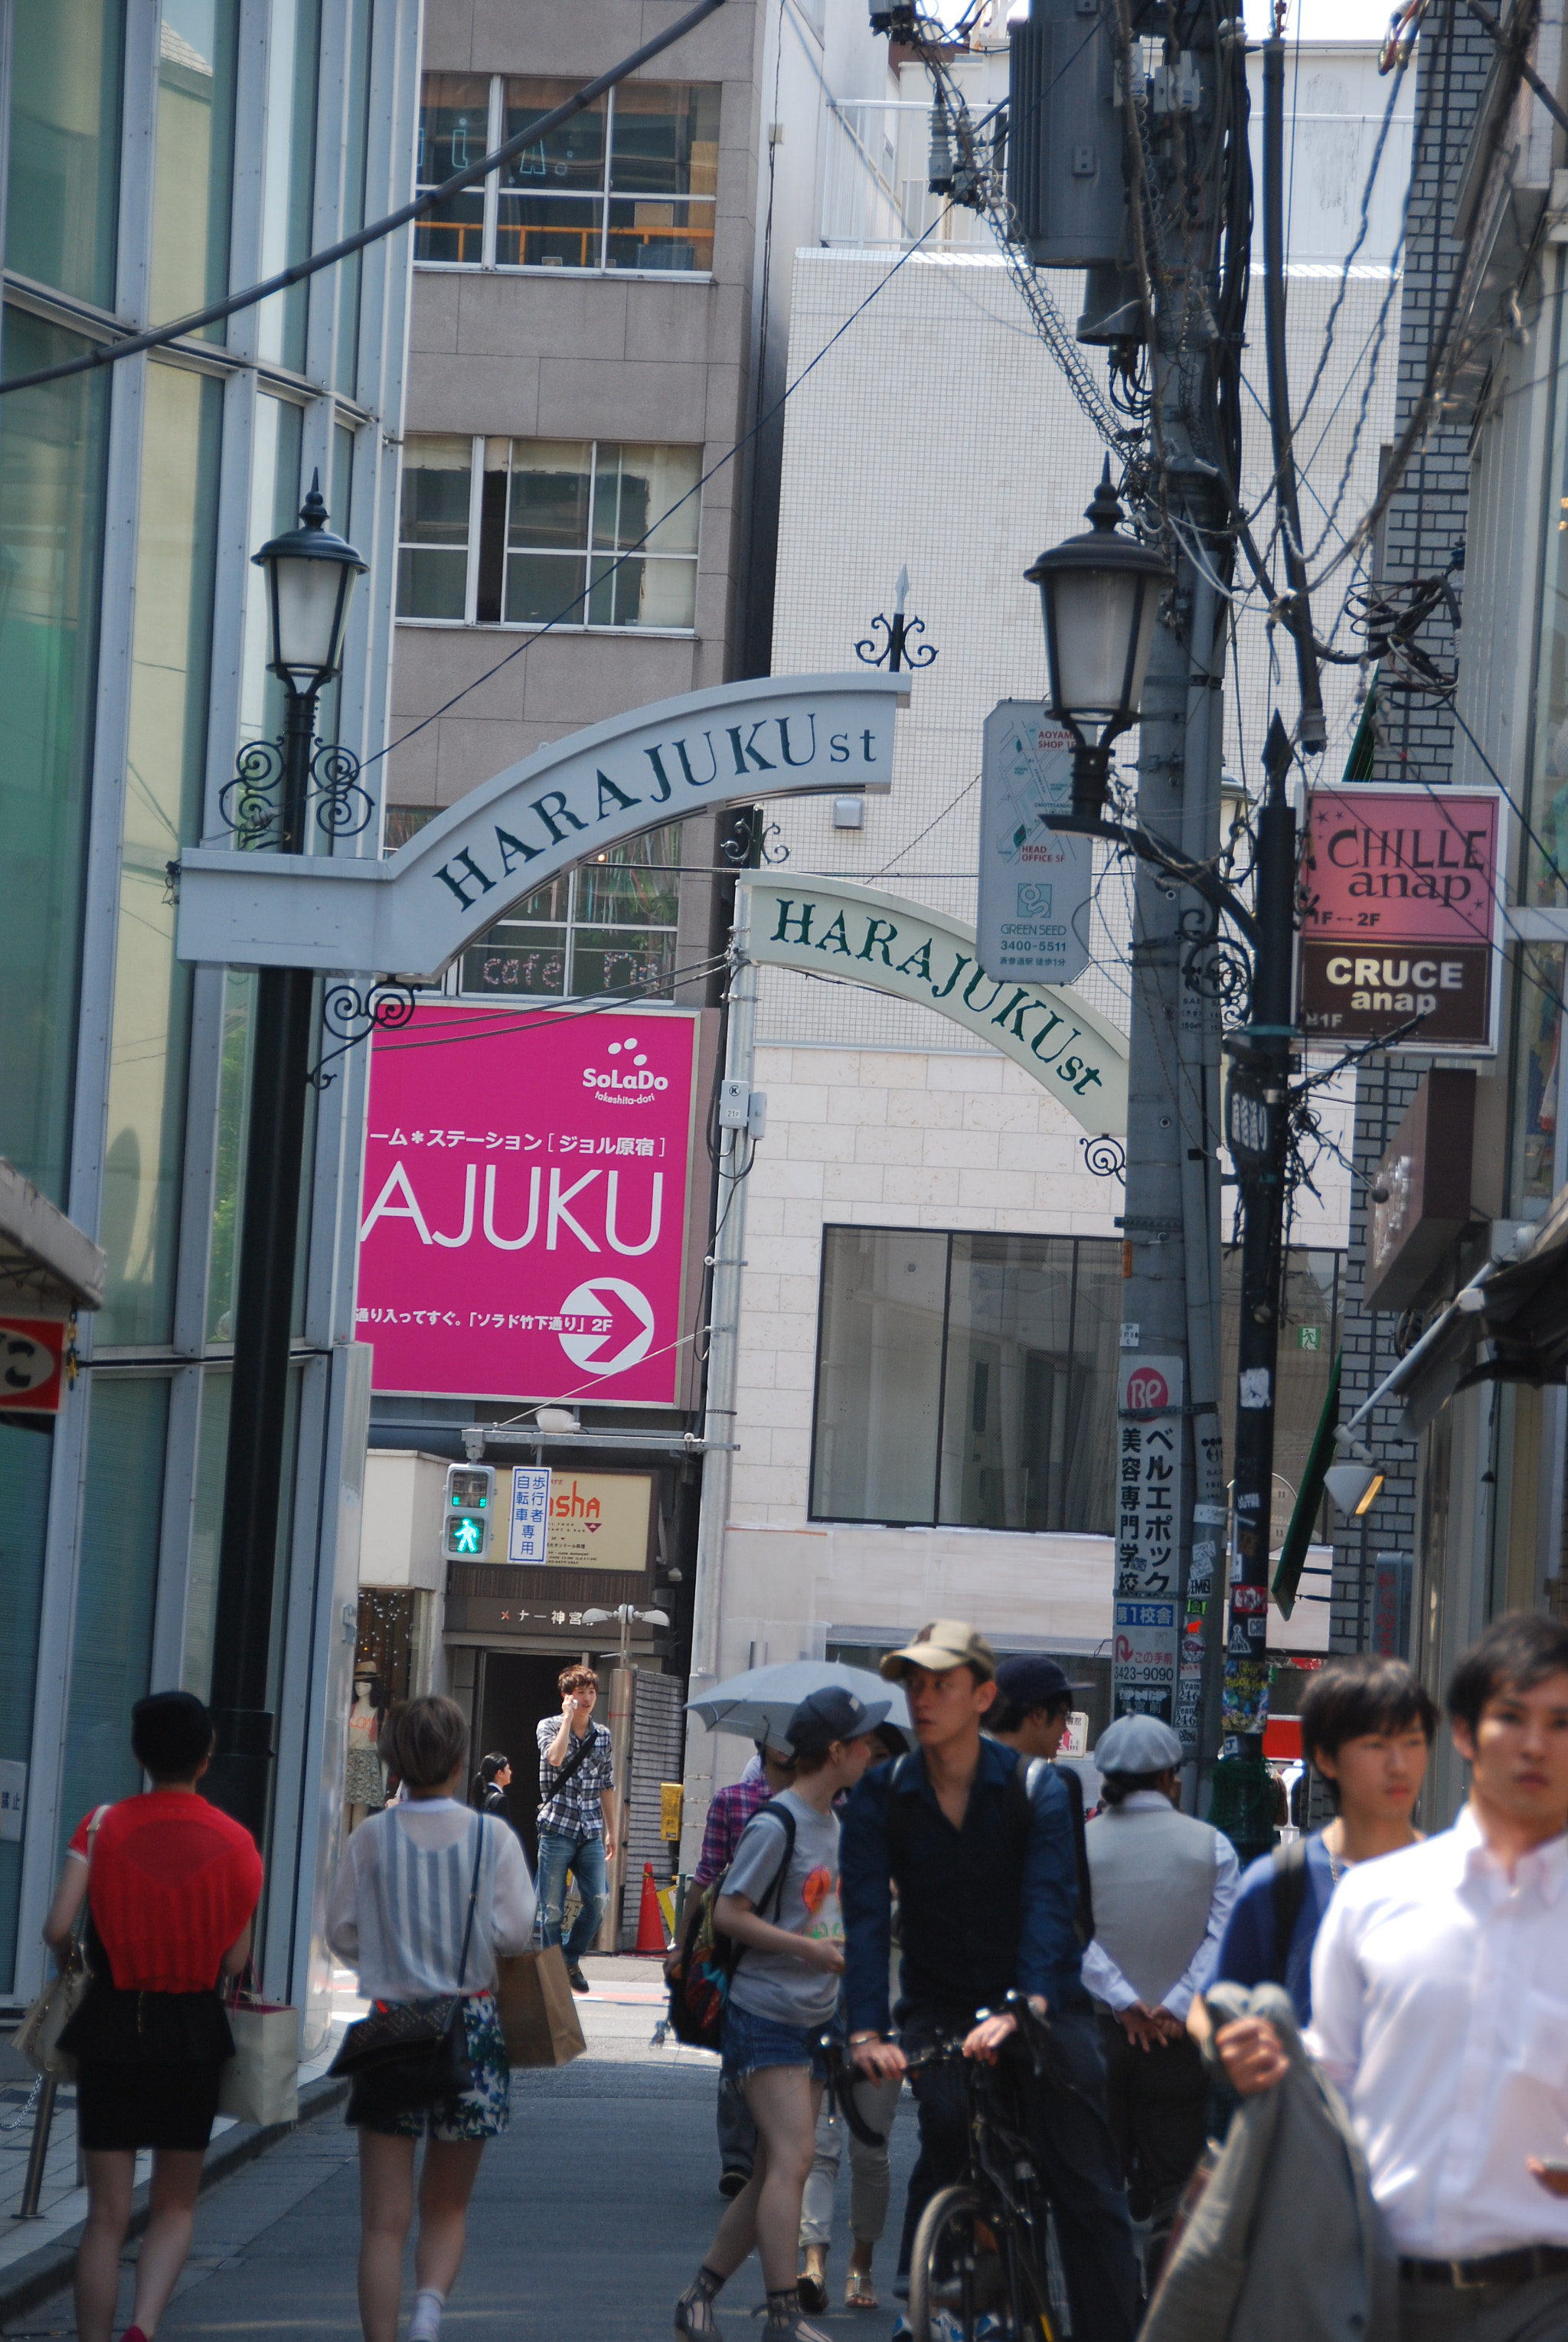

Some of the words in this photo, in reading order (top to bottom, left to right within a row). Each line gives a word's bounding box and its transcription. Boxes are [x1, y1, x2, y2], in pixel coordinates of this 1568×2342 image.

[1038, 730, 1076, 740] AOYAM
[1038, 740, 1063, 749] SHOP
[1022, 845, 1047, 854] HEAD
[1328, 825, 1487, 870] CHILLE
[1348, 871, 1472, 908] anap
[1357, 913, 1380, 926] 2F
[1001, 923, 1037, 935] GREEN
[1039, 925, 1067, 936] SEED
[1001, 941, 1067, 952] 3400-5511
[1326, 957, 1464, 989] CRUCE
[1351, 991, 1436, 1014] anap
[582, 1068, 668, 1090] SoLaDo
[595, 1091, 655, 1105] takeshita-dori
[360, 1161, 663, 1256] AJUKU
[592, 1319, 612, 1332] 2F
[514, 1475, 530, 1522] 自転車
[530, 1476, 546, 1523] 歩行者
[1118, 1428, 1142, 1592] 美容専門学校
[1145, 1428, 1174, 1592] ベルエポック
[521, 1524, 535, 1556] 専用
[501, 1609, 594, 1626] メナー神宮
[1116, 1606, 1173, 1625] 第1校舎
[1135, 1652, 1173, 1664] この手前
[1114, 1666, 1174, 1681] 3423-9090
